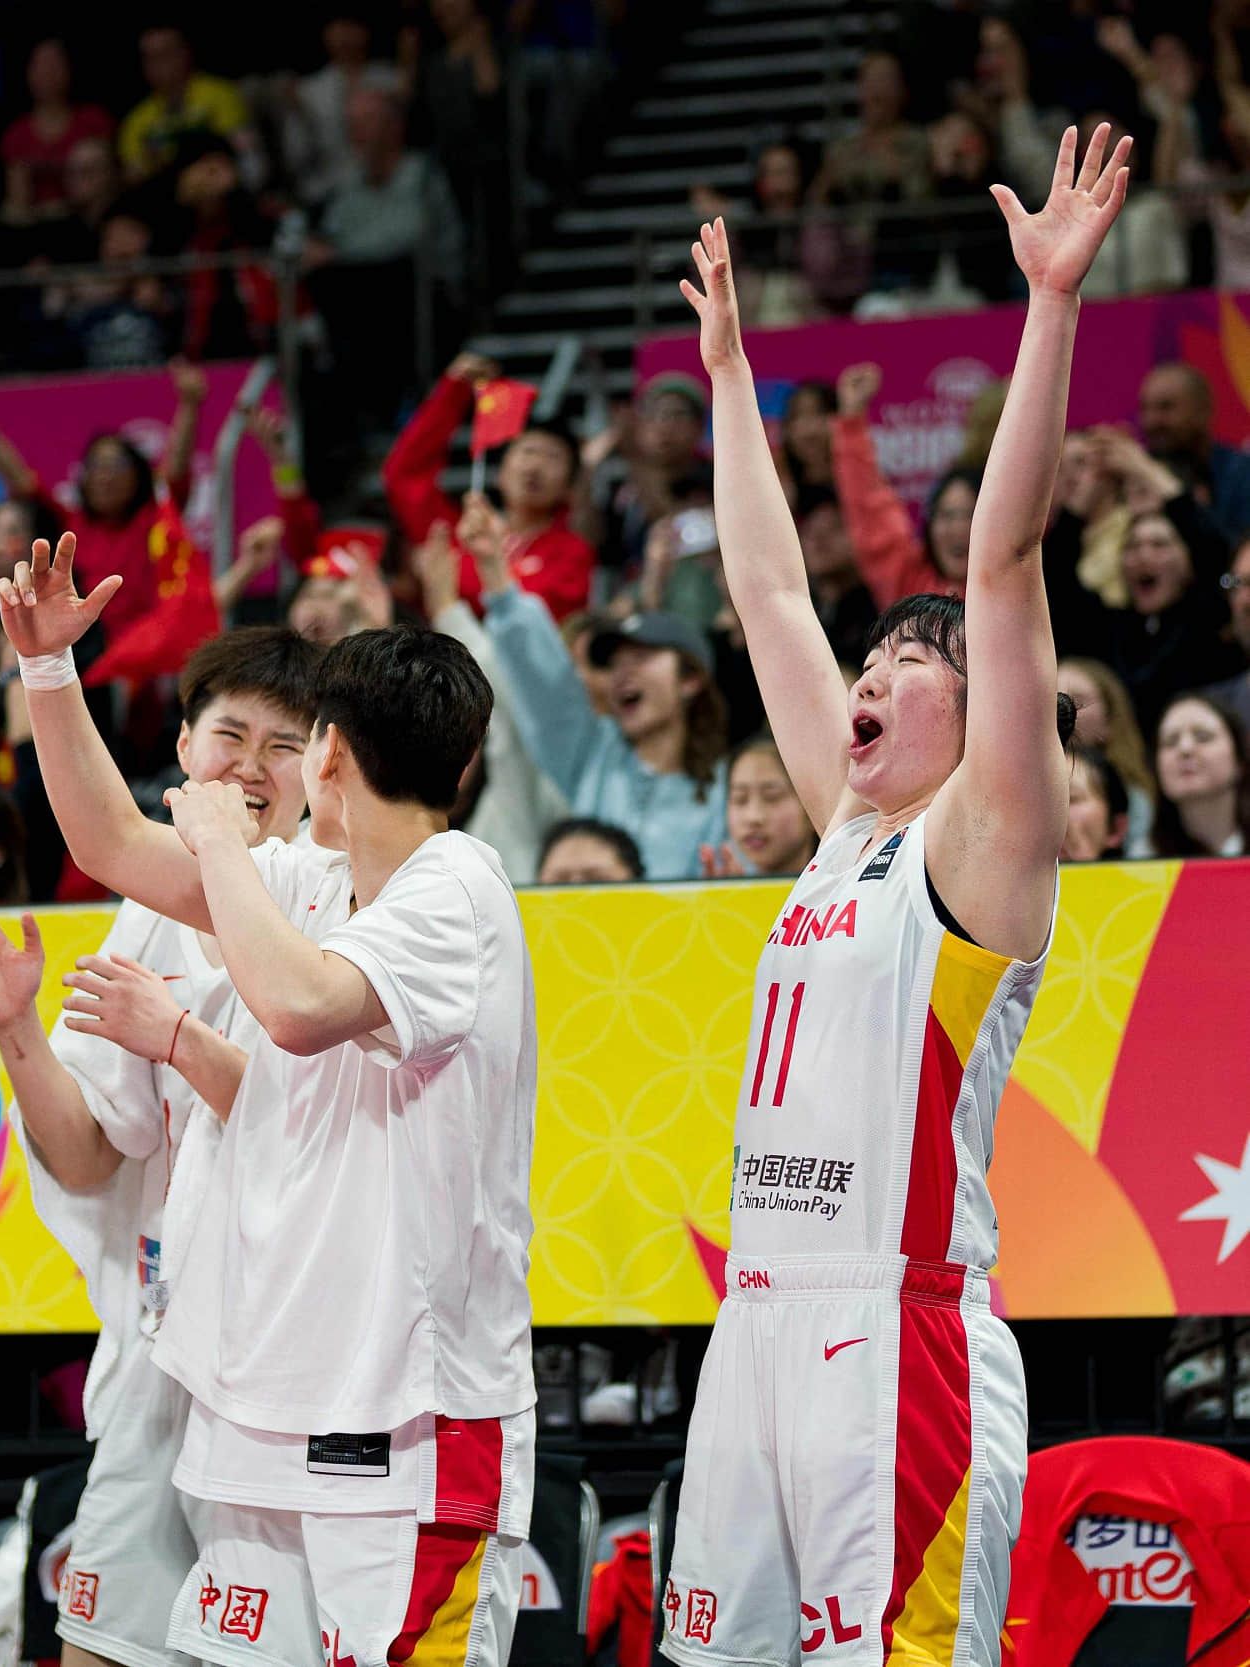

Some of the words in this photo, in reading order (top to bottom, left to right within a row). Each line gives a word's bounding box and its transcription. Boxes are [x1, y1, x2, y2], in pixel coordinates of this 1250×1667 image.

[767, 900, 857, 947] HINA
[750, 981, 806, 1108] 11
[738, 1189, 766, 1209] China
[742, 1153, 855, 1194] 中国银联
[738, 1270, 771, 1290] CHN
[64, 1570, 100, 1622] 国
[198, 1572, 269, 1642] 中国
[665, 1578, 718, 1644] 中国
[800, 1595, 862, 1653] CL
